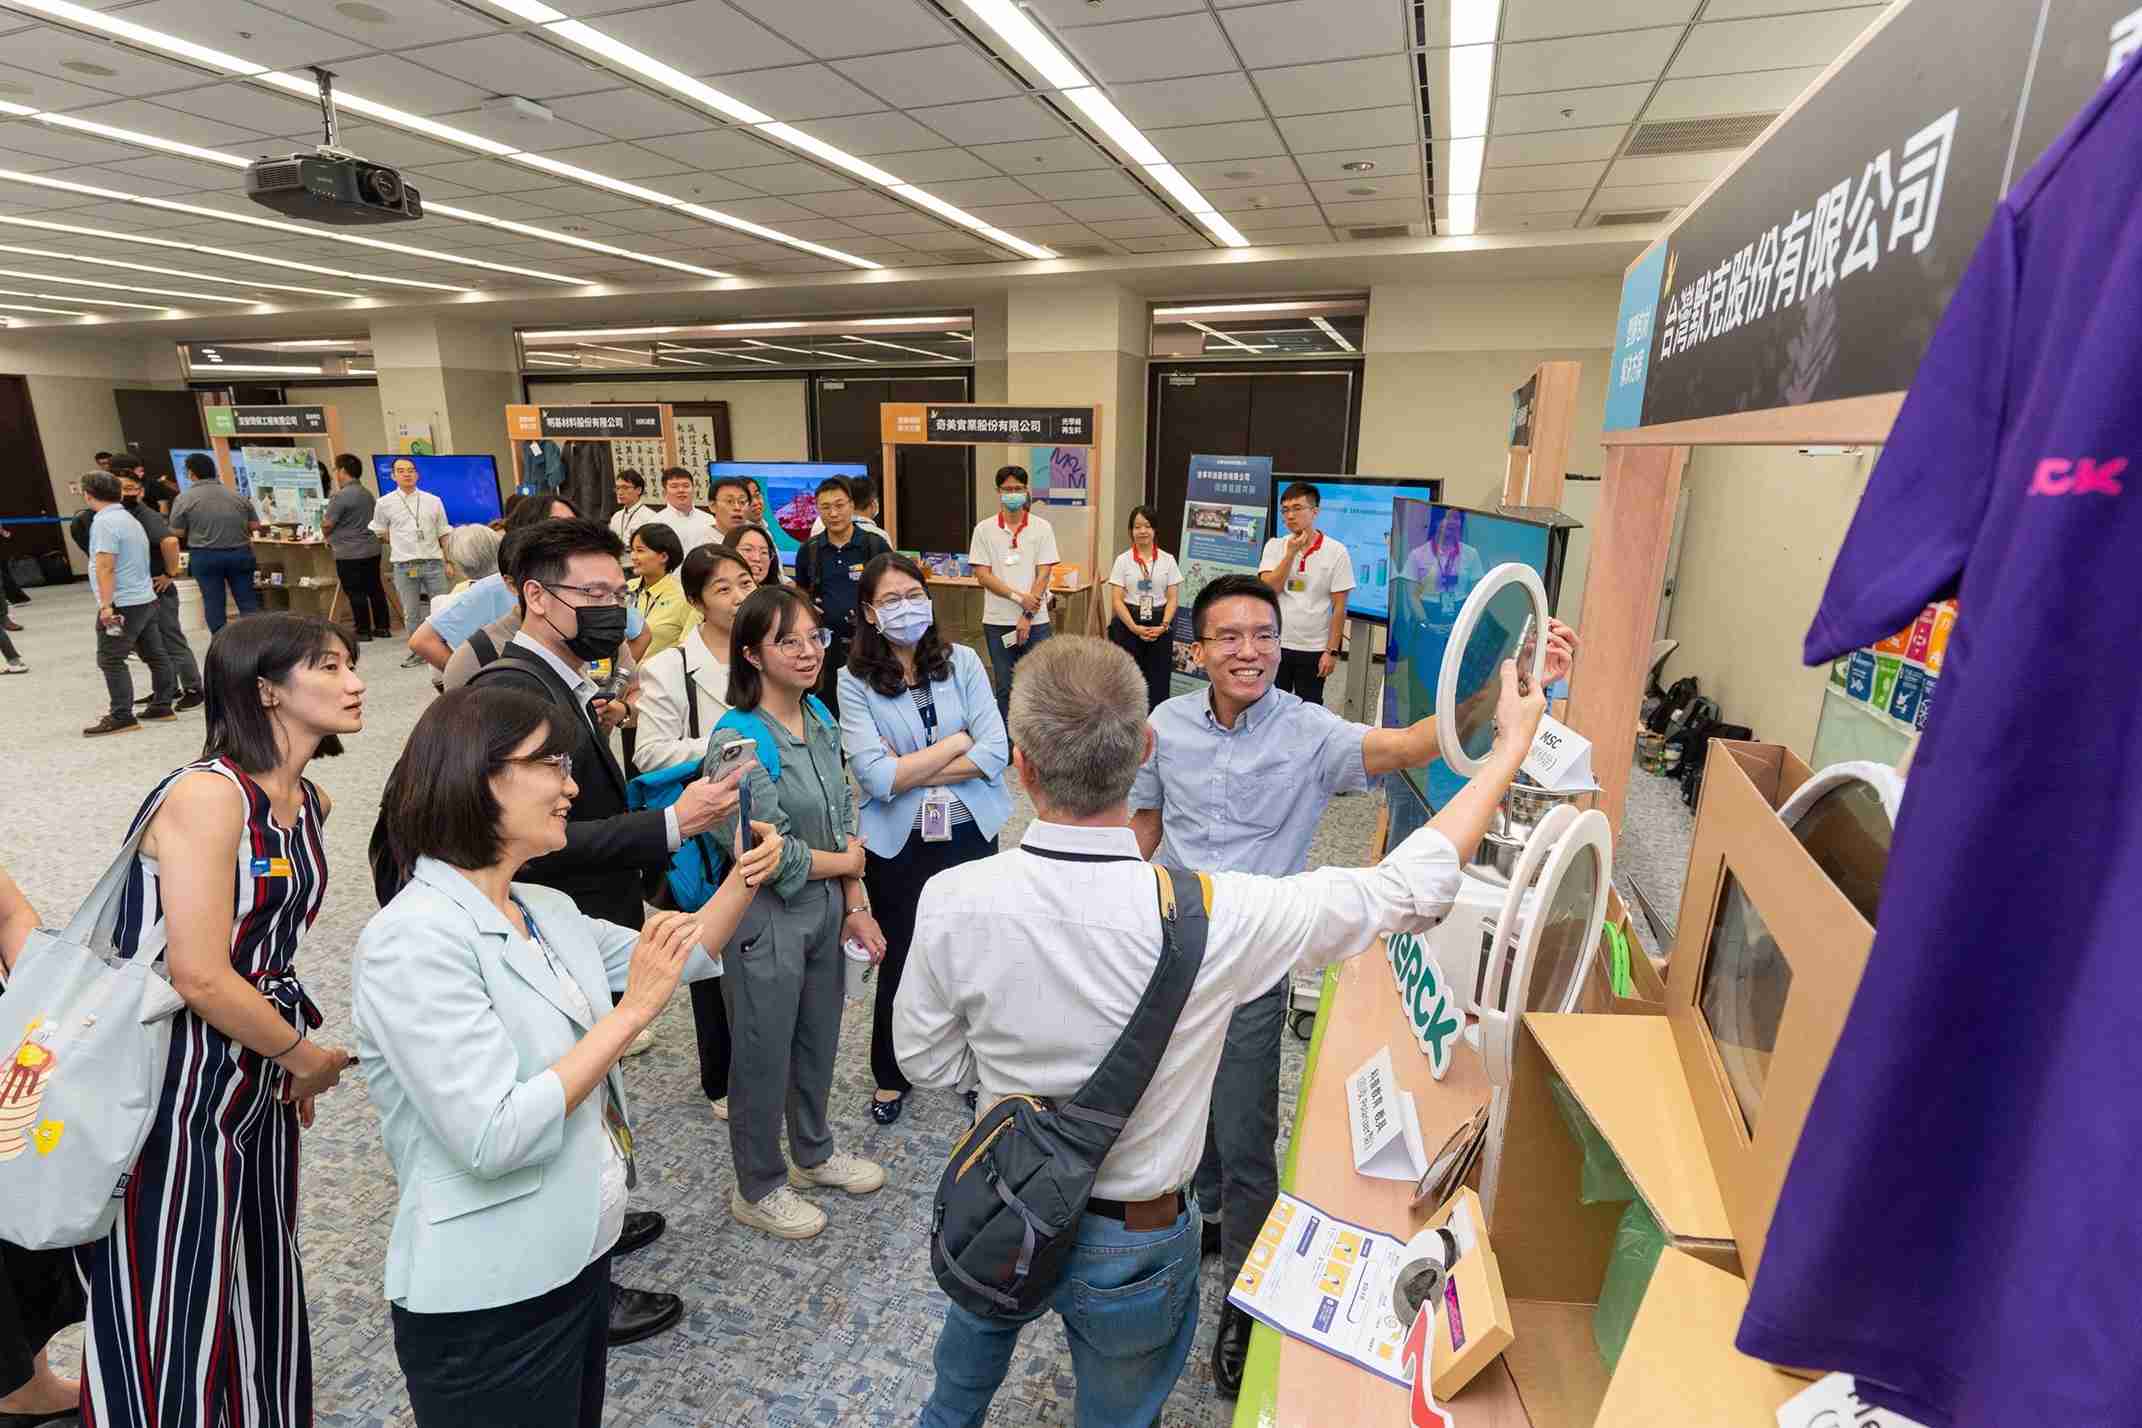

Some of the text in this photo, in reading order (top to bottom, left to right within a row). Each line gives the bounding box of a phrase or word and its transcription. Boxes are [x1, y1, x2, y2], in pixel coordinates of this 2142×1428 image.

[1661, 107, 1960, 361] 台灣默克股份有限公司
[936, 418, 1041, 433] 奇美實業股份有限公司
[2030, 456, 2129, 497] CK
[1540, 730, 1562, 750] MSC
[1388, 932, 1458, 1068] ERCK
